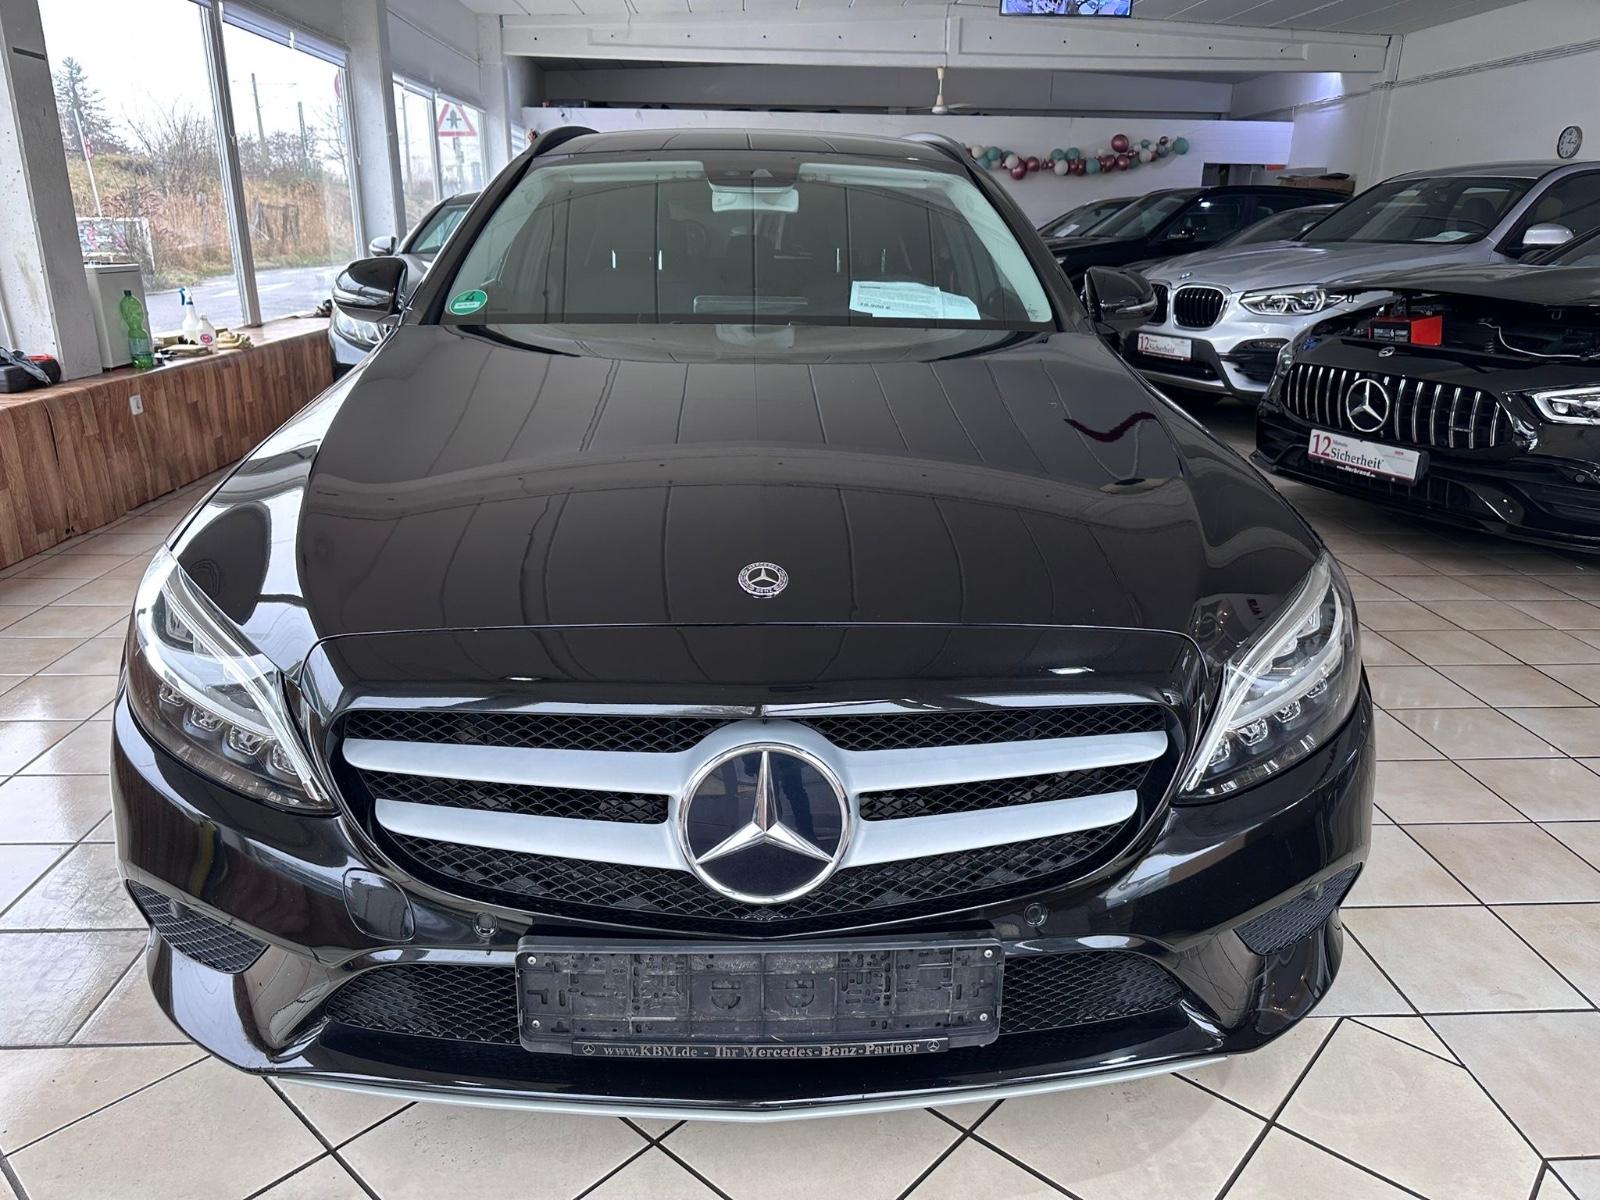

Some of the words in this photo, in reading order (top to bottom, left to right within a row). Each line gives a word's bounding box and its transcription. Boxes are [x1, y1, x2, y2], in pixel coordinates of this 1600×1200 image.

[1140, 336, 1150, 351] 12
[1312, 433, 1332, 458] 12
[603, 1045, 698, 1058] www.KBM.de
[715, 1046, 739, 1058] Ihr
[743, 1043, 920, 1058] Mercedes-Benz-Partner
